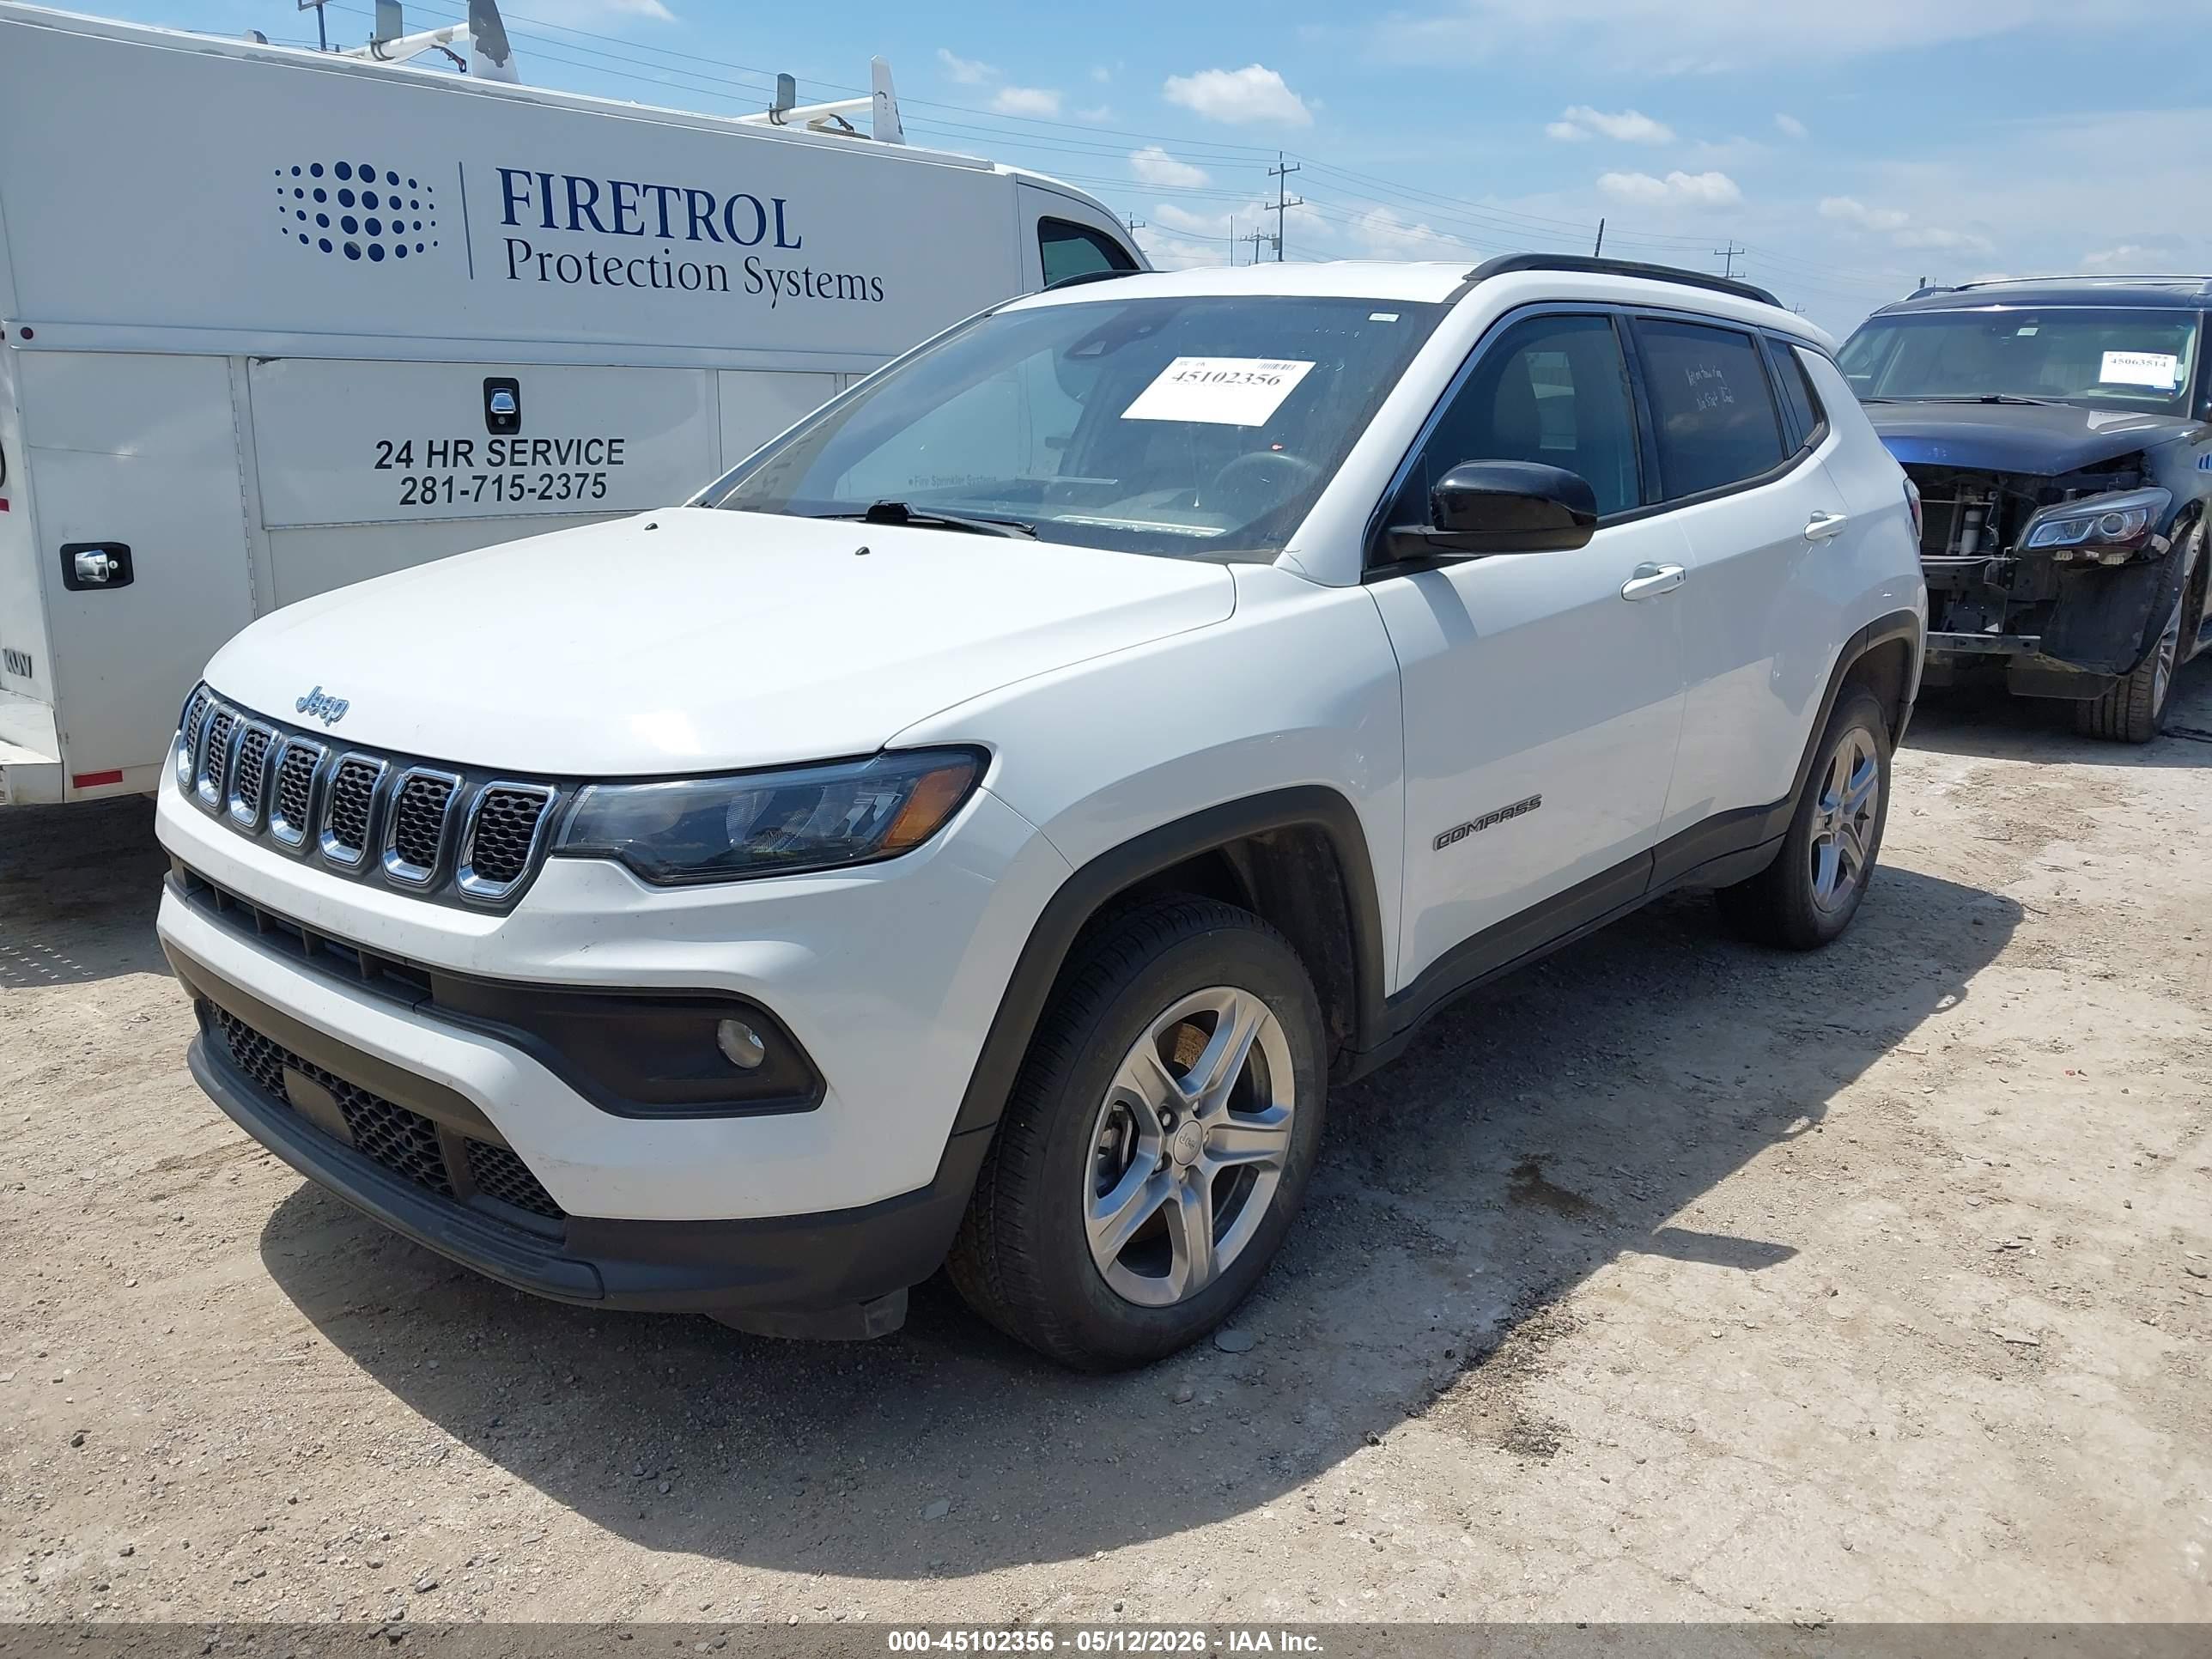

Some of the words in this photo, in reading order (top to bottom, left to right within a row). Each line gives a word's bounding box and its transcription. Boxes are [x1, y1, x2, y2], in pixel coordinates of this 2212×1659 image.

[495, 167, 802, 249] FIRETROL
[502, 237, 731, 292] Protection
[744, 256, 884, 310] Systems
[1171, 370, 1286, 386] 45102356
[2110, 358, 2166, 368] 45063514
[374, 440, 414, 469] 24
[427, 440, 474, 468] HR
[486, 439, 625, 467] SERVICE
[399, 472, 607, 505] 281-715-2375
[295, 685, 349, 727] Jeep
[1433, 793, 1542, 851] COMPASS
